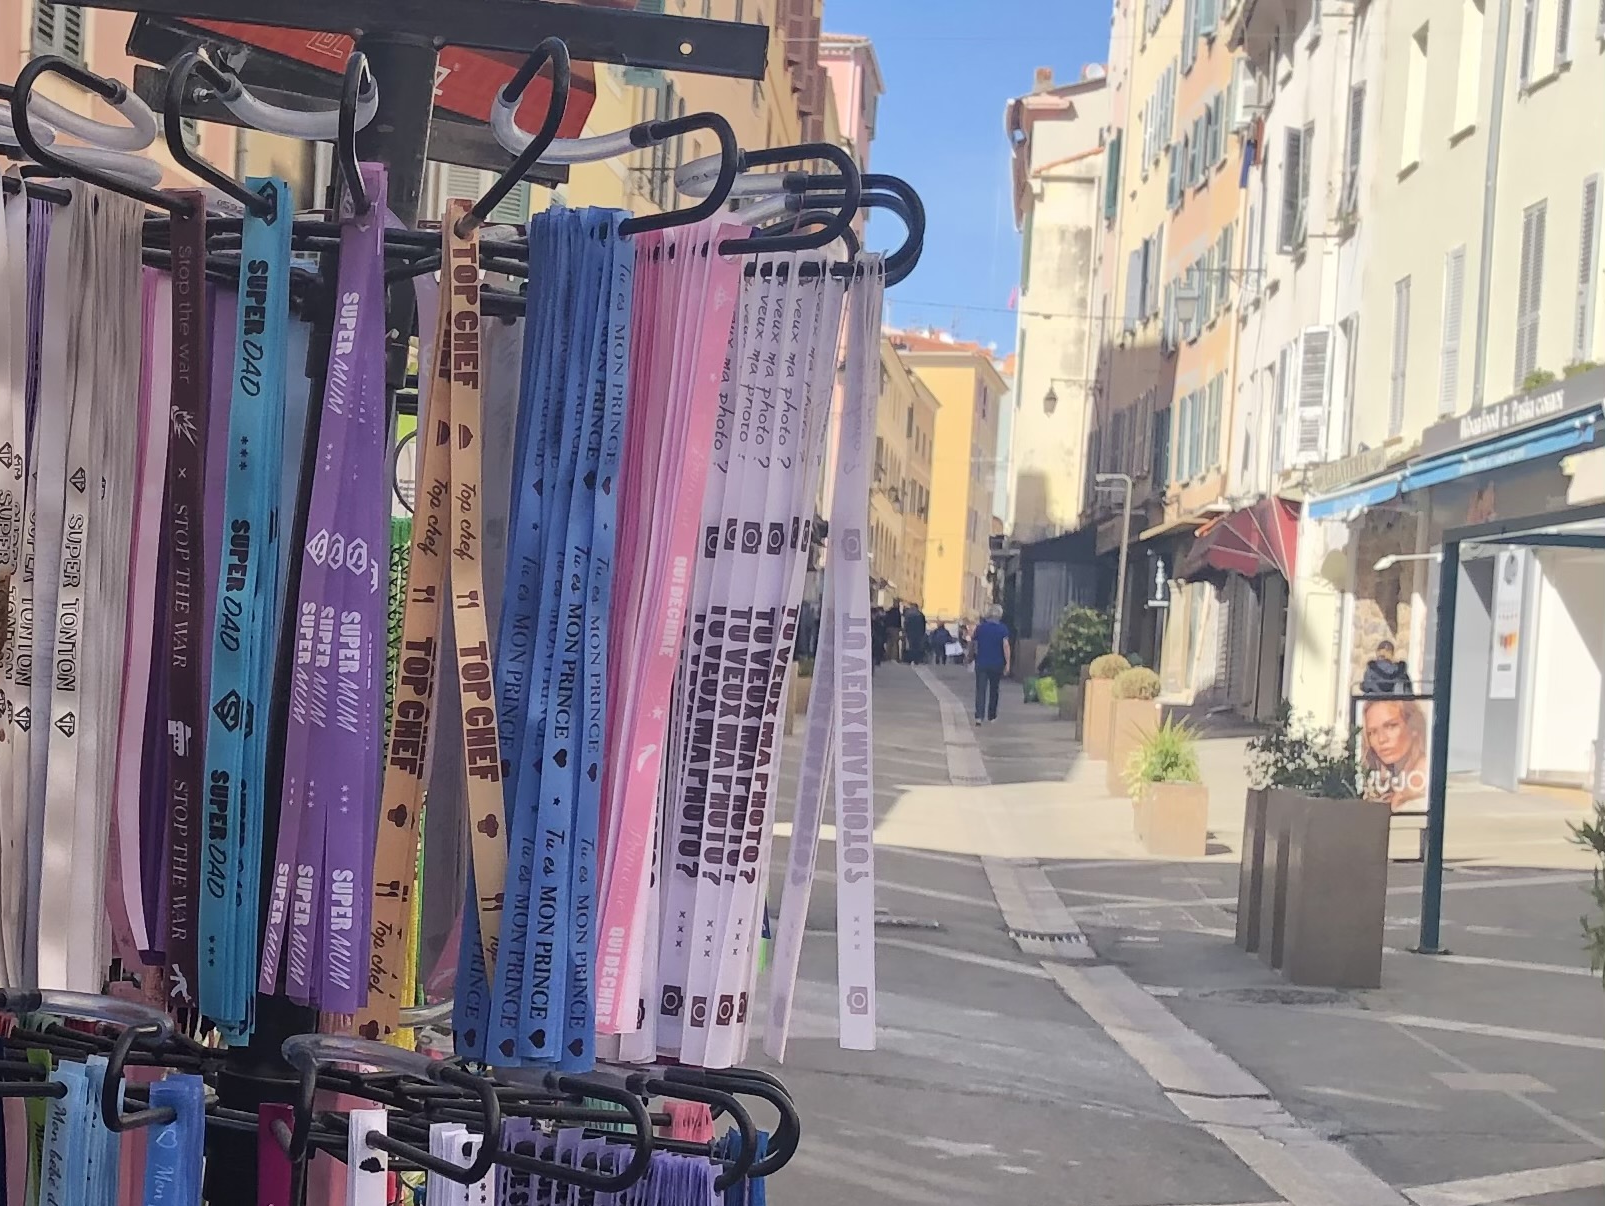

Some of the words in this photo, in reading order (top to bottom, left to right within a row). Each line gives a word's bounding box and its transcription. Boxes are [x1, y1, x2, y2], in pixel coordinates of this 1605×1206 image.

[178, 245, 193, 294] Stop
[243, 260, 269, 333] SUPER
[452, 242, 479, 303] TOP
[178, 299, 192, 338] the
[333, 291, 362, 356] SUPER
[768, 296, 783, 344] veux
[789, 296, 805, 344] veux
[177, 345, 190, 384] war
[241, 340, 264, 398] DAD
[453, 310, 479, 391] CHEF
[609, 324, 627, 374] MON
[784, 351, 796, 380] ma
[327, 360, 350, 417] MUM
[753, 386, 773, 447] photo
[776, 388, 794, 447] photo
[604, 379, 624, 466] PRINCE
[711, 391, 735, 454] photo
[432, 476, 450, 510] Top
[458, 481, 477, 516] Top
[63, 513, 84, 588] SUPER
[173, 503, 190, 563] STOP
[225, 518, 251, 593] SUPER
[455, 517, 477, 562] chef
[174, 570, 191, 610] THE
[57, 598, 80, 692] TONTON
[170, 618, 189, 669] WAR
[219, 596, 243, 653] DAD
[294, 602, 316, 666] SUPER
[336, 610, 362, 674] SUPER
[564, 602, 583, 654] MON
[587, 614, 601, 654] MON
[728, 606, 753, 643] TU
[753, 607, 776, 644] TU
[401, 635, 433, 696] TOP
[459, 640, 490, 703] TOP
[692, 638, 722, 713] VEUX
[719, 647, 747, 720] VEUX
[762, 643, 788, 720] VEUX
[290, 667, 310, 726] MUM
[553, 653, 577, 740] PRINCE
[586, 660, 601, 754] PRINCE
[388, 699, 428, 777] CHEF
[464, 707, 500, 783] CHEF
[711, 724, 740, 769] MA
[753, 722, 776, 769] MA
[173, 780, 190, 835] STOP
[206, 769, 230, 845] SUPER
[675, 775, 708, 880] PHOTO?
[702, 773, 733, 887] PHOTO?
[738, 772, 769, 886] PHOTO?
[172, 841, 189, 882] THE
[207, 846, 229, 899] DAD
[169, 888, 188, 941] WAR
[292, 864, 314, 926] SUPER
[329, 869, 354, 931] SUPER
[537, 890, 558, 932] MON
[574, 894, 591, 941] MON
[372, 919, 394, 955] Top
[607, 926, 625, 952] QUI
[530, 934, 555, 1022] PRINCE
[567, 945, 590, 1030] PRINCE
[49, 1103, 67, 1149] Mon
